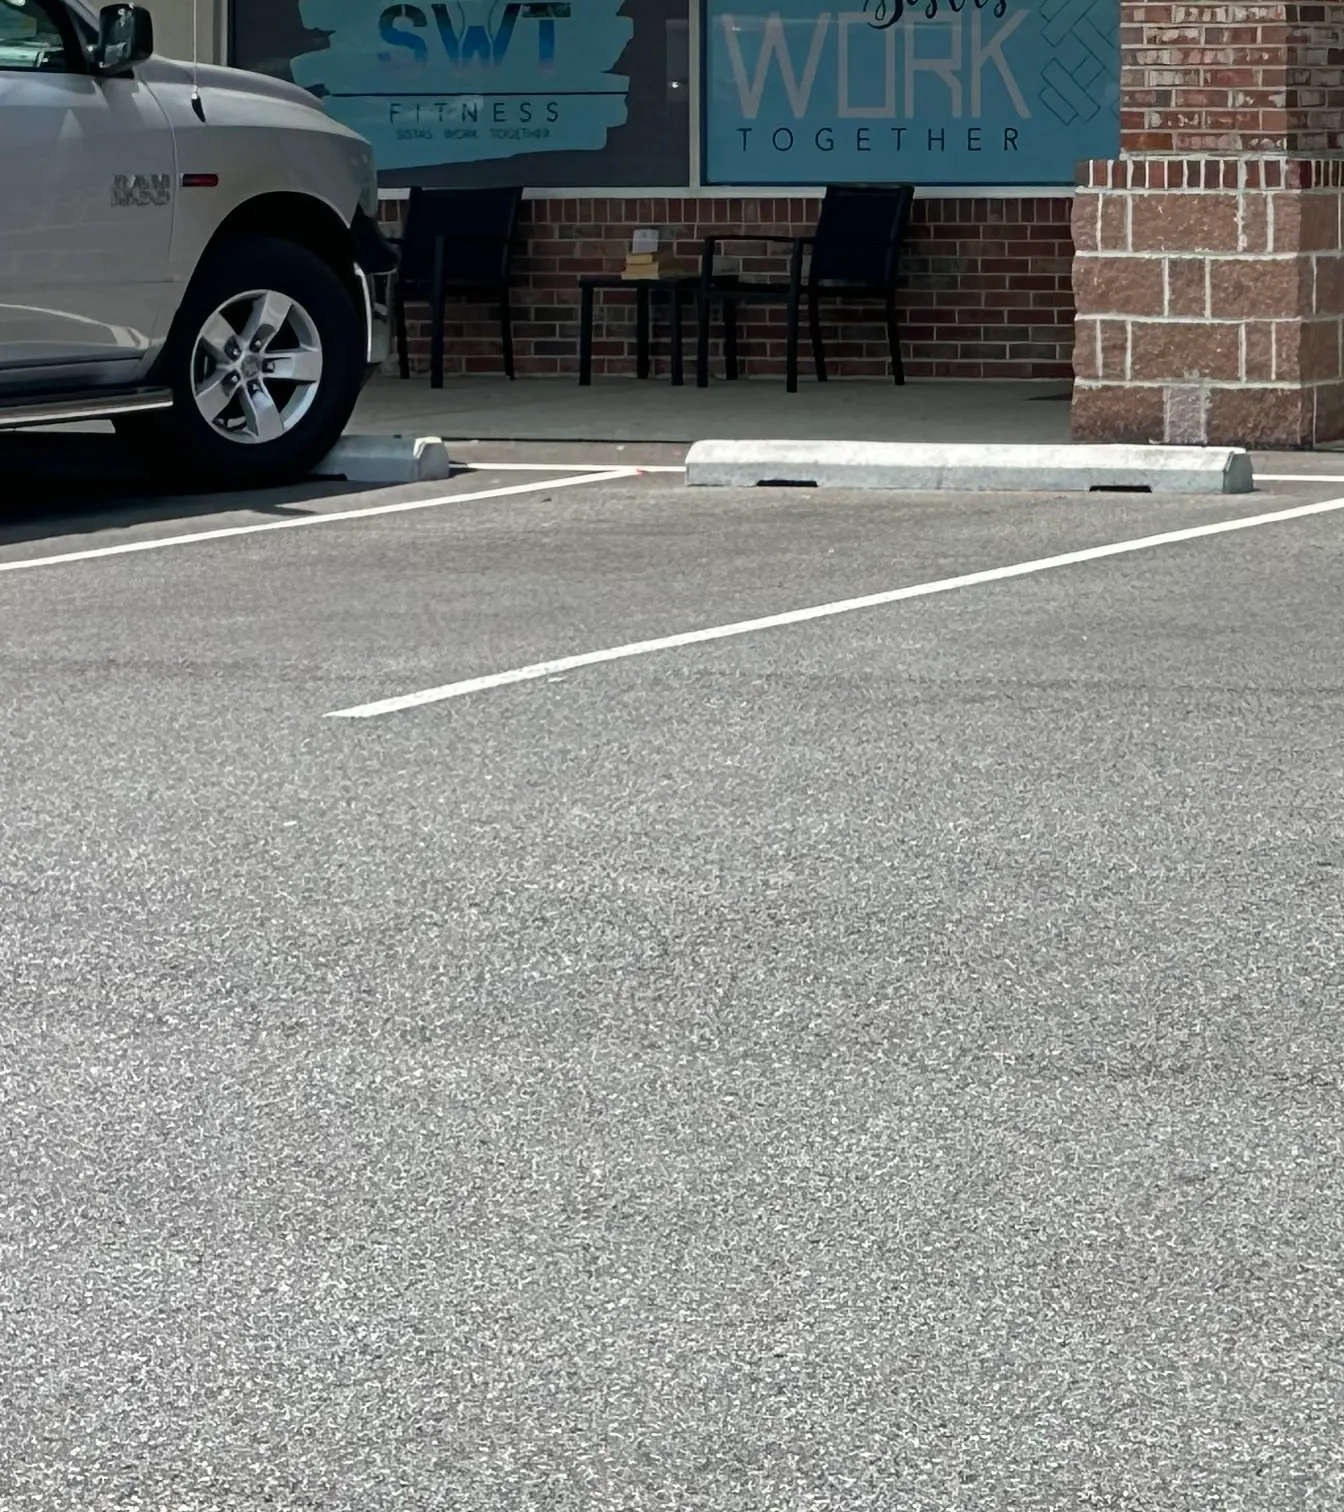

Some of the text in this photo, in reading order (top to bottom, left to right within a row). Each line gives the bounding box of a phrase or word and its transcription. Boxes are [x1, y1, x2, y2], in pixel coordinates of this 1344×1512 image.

[377, 1, 573, 78] SWT
[720, 9, 1032, 120] WORK
[389, 101, 559, 124] FITNESS
[736, 127, 1020, 152] TOGETHER
